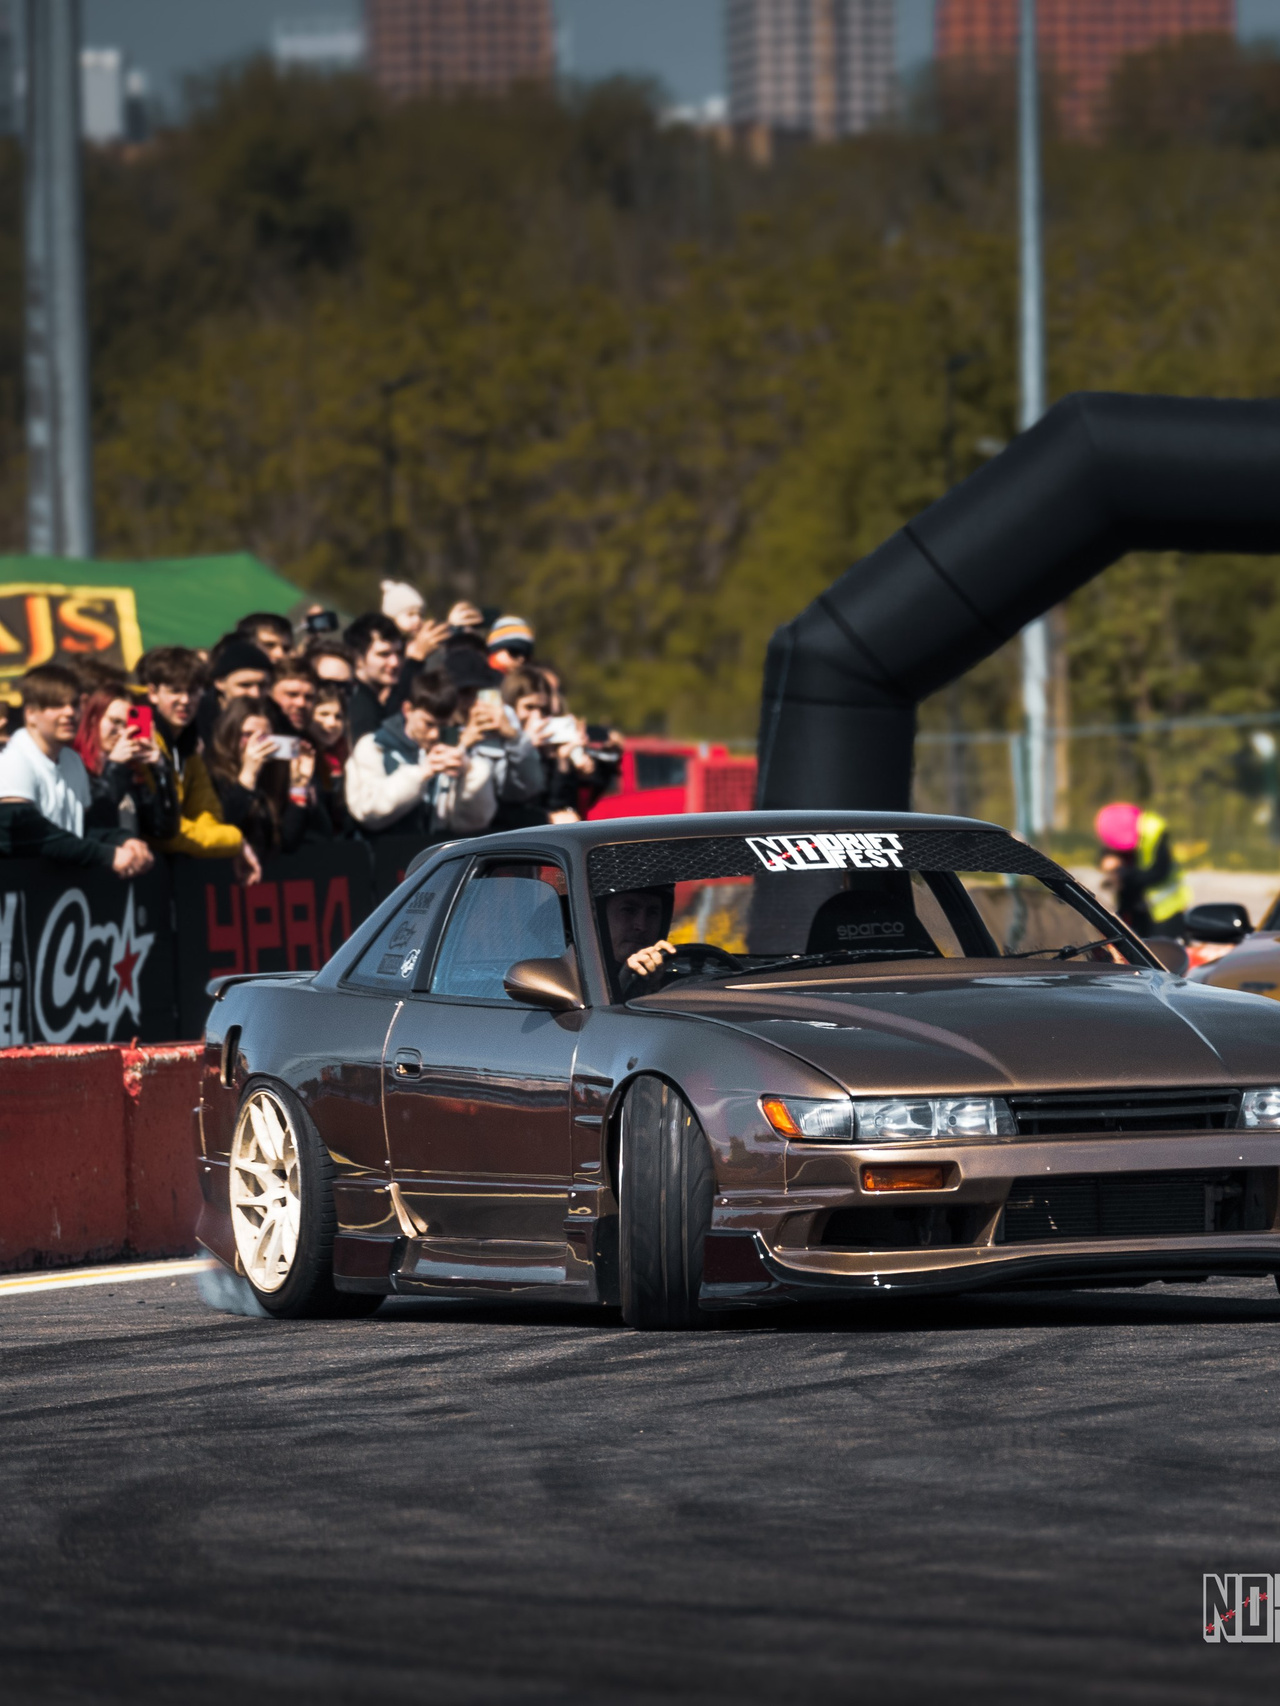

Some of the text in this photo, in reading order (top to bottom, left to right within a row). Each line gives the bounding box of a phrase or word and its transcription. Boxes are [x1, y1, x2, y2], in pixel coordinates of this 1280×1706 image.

[815, 833, 904, 850] DRIFT
[833, 849, 904, 868] FEST
[836, 921, 905, 940] sparco
